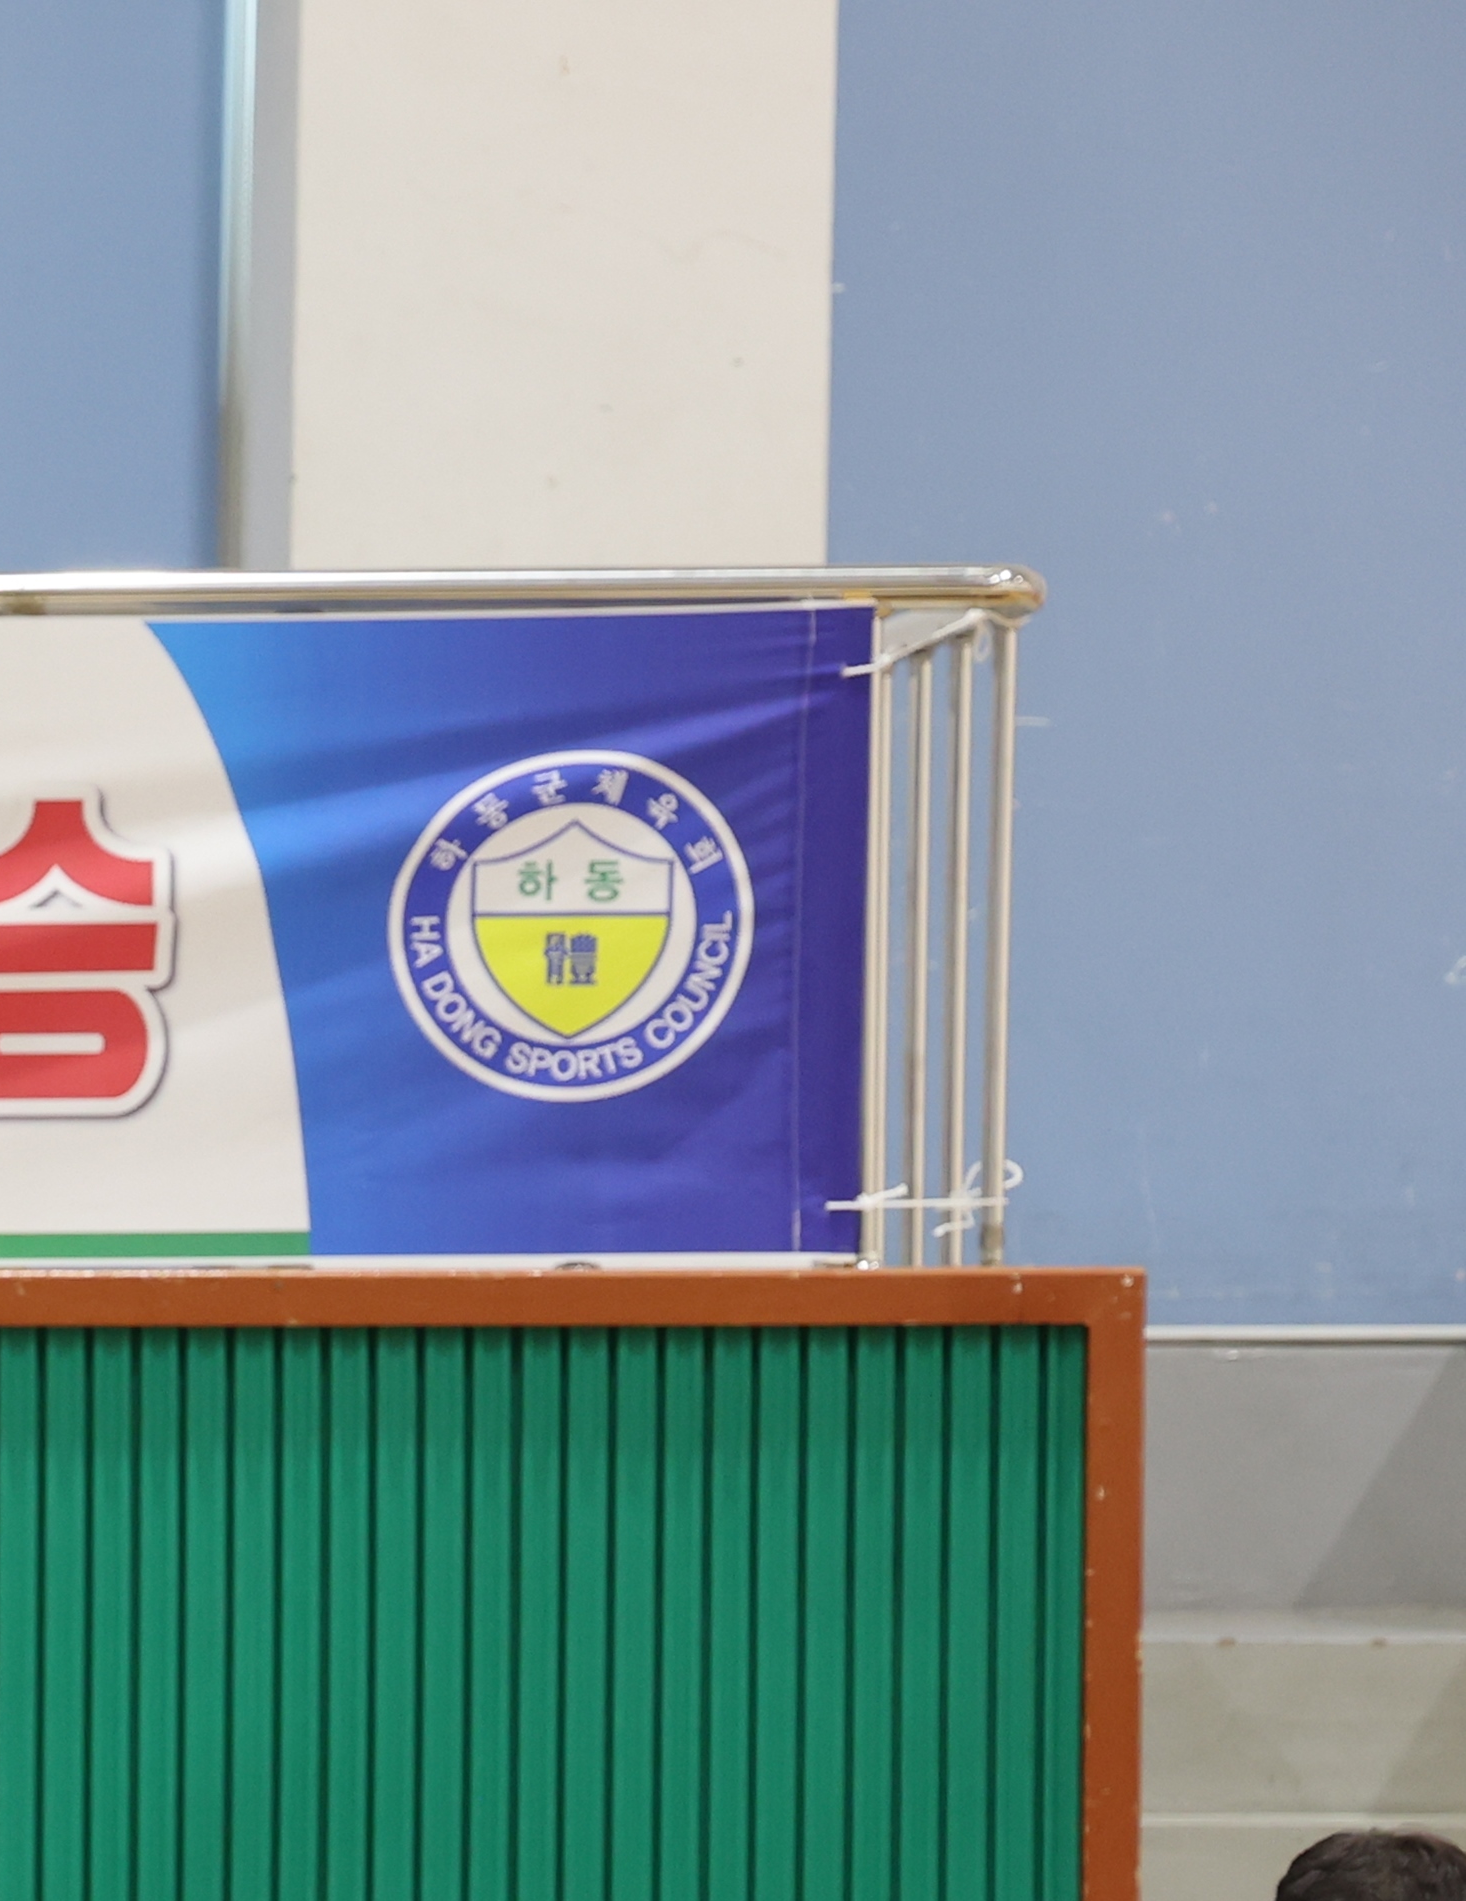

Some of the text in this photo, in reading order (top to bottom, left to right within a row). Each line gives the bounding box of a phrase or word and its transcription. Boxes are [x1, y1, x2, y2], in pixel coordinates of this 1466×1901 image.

[518, 859, 623, 902] 하동
[410, 910, 734, 1082] HA DONG SPORTS COUNCIL
